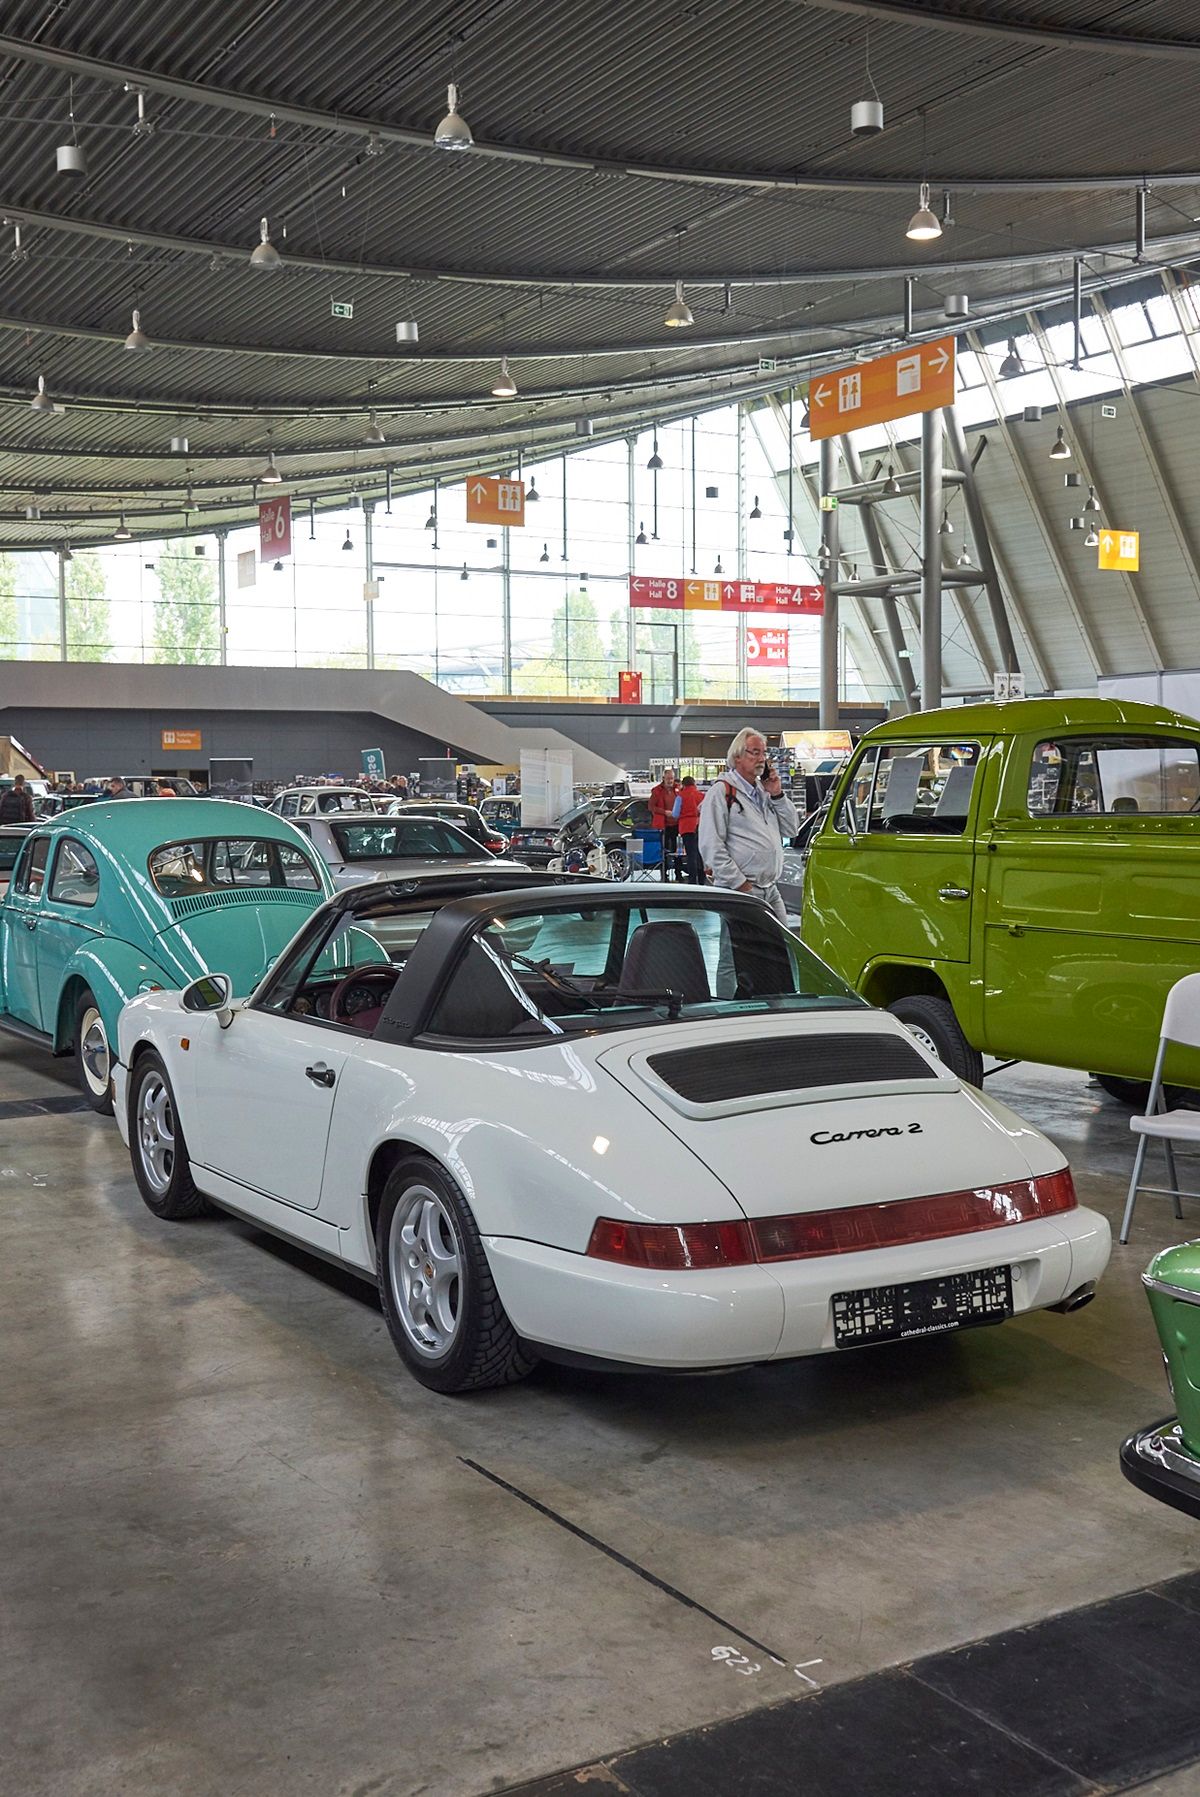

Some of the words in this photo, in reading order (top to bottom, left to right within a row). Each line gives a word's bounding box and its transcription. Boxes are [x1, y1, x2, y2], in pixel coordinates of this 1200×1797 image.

[261, 508, 275, 523] Halle
[275, 505, 286, 539] 6
[261, 528, 273, 543] Hall
[649, 580, 667, 588] Halle
[667, 580, 678, 599] 8
[649, 591, 663, 599] Hall
[775, 586, 792, 595] Halle
[791, 587, 803, 605] 4
[775, 596, 789, 605] Hall
[810, 1127, 904, 1145] Carrera
[907, 1122, 923, 1134] 2
[900, 1321, 960, 1338] cathedral-classics.com
